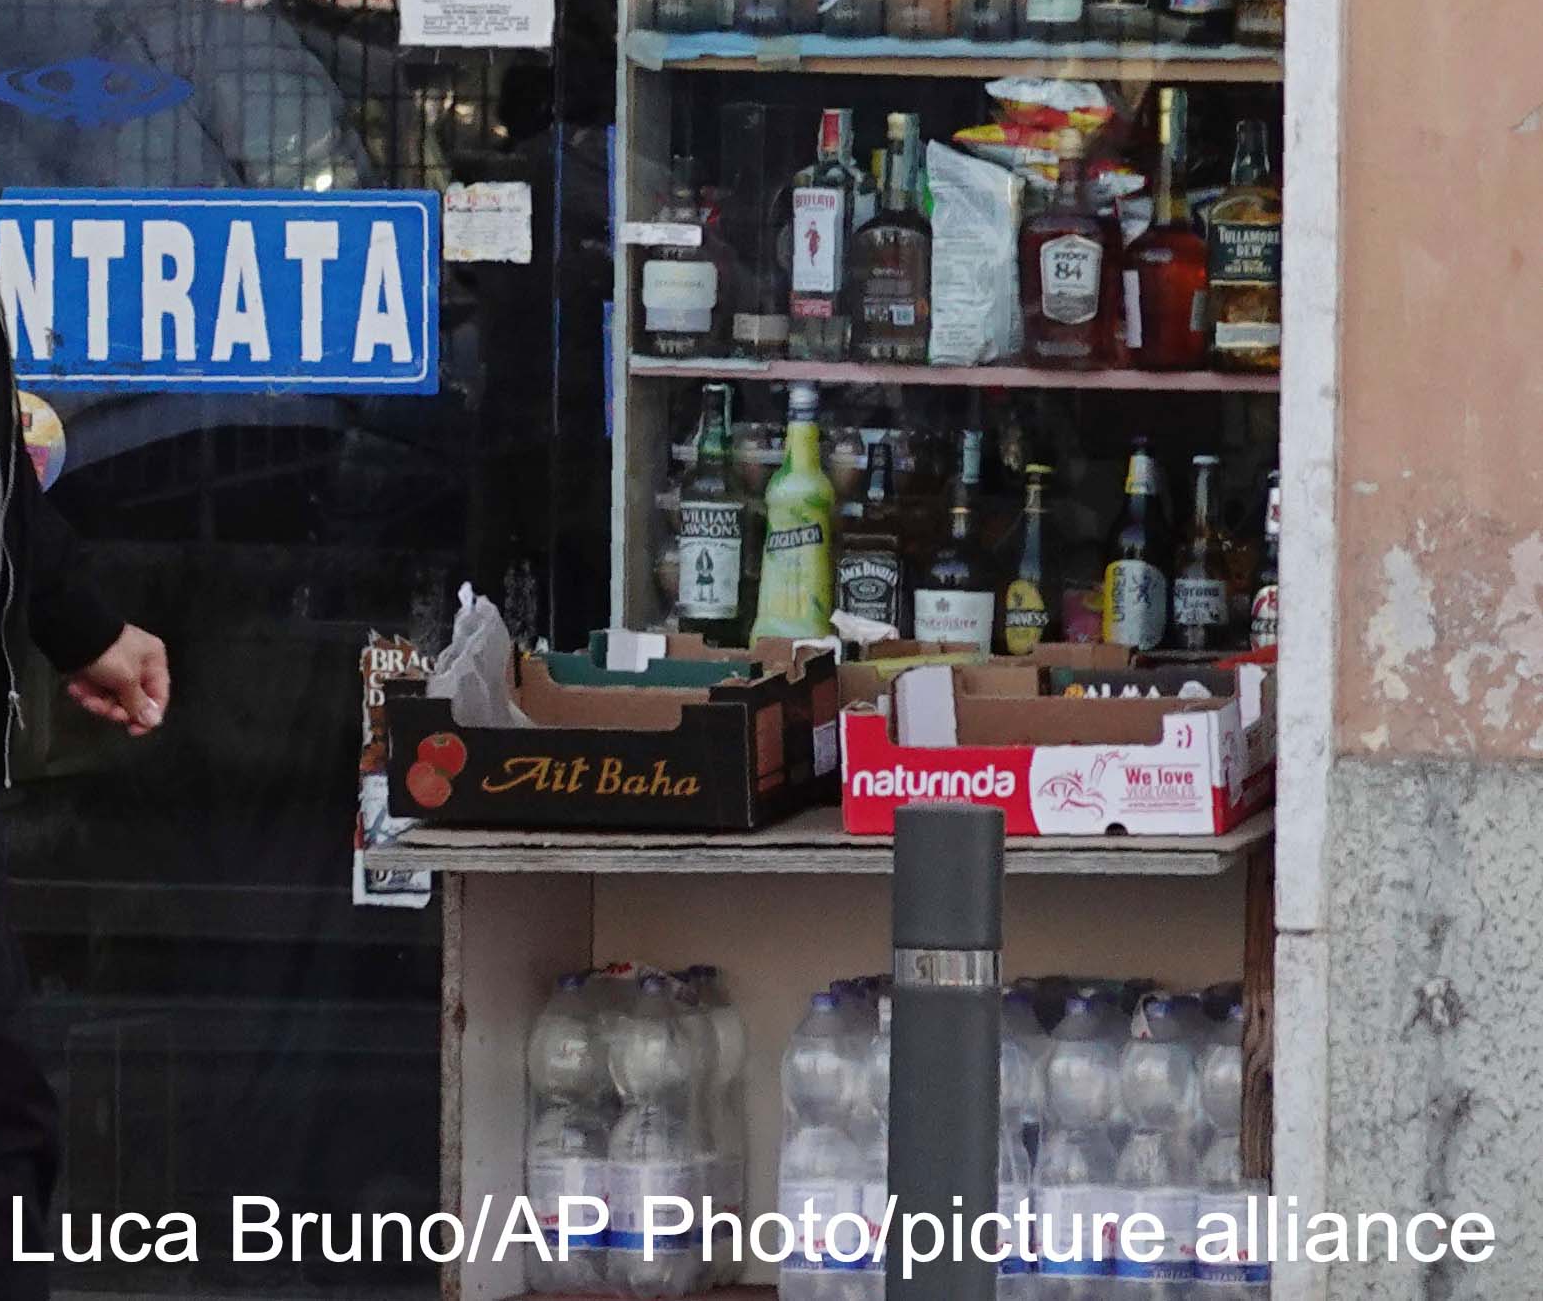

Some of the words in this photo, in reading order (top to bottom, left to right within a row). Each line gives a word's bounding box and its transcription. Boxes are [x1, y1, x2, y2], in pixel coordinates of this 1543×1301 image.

[1053, 263, 1083, 280] 84
[682, 509, 738, 525] WILLIAM
[595, 756, 702, 796] Baha
[851, 764, 1016, 798] naturinda
[1124, 767, 1152, 786] We
[1157, 767, 1194, 785] love
